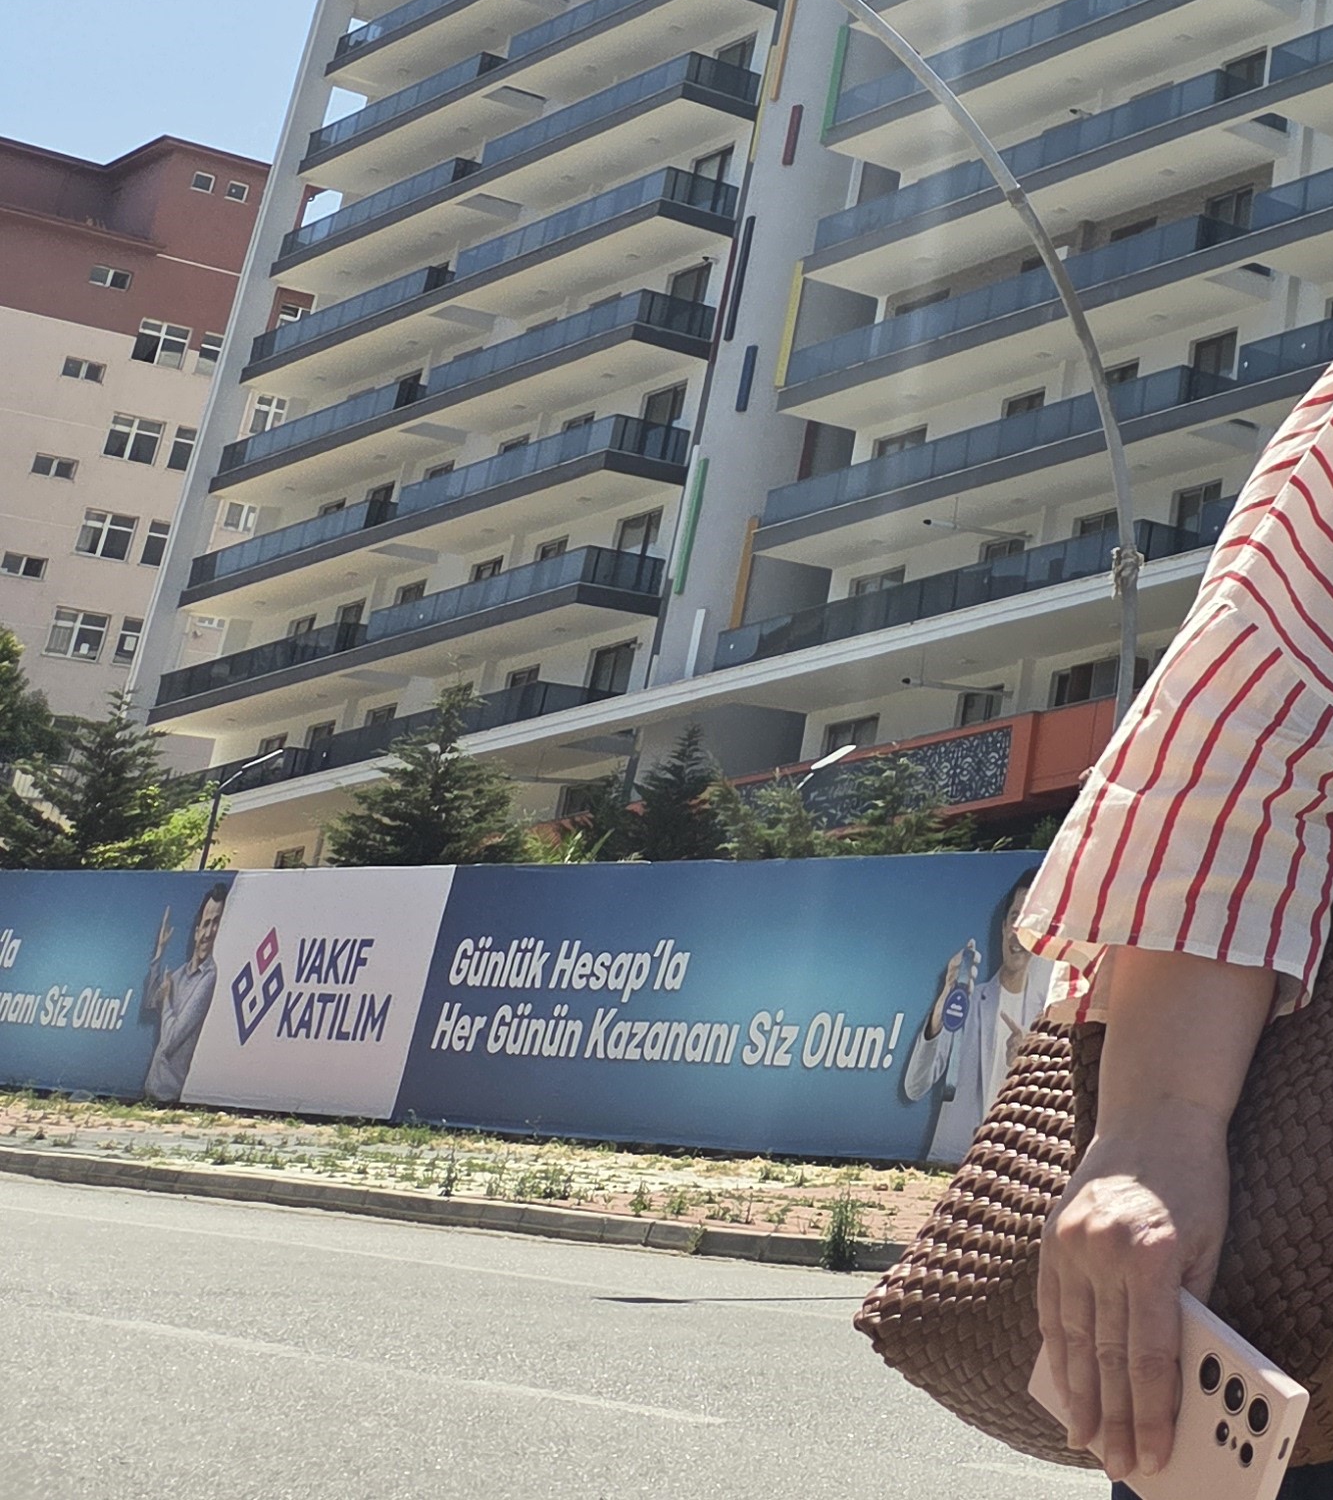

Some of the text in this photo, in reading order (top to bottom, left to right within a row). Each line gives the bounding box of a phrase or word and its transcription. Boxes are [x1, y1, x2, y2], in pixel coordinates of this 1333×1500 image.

[295, 937, 375, 985] VAKIF
[449, 936, 690, 1003] Günlük Hesap'la
[40, 984, 74, 1027] Siz
[72, 987, 133, 1030] Olun!
[276, 990, 393, 1042] KATILIM
[430, 1001, 904, 1069] Her Günün Kazananı Siz Olun!
